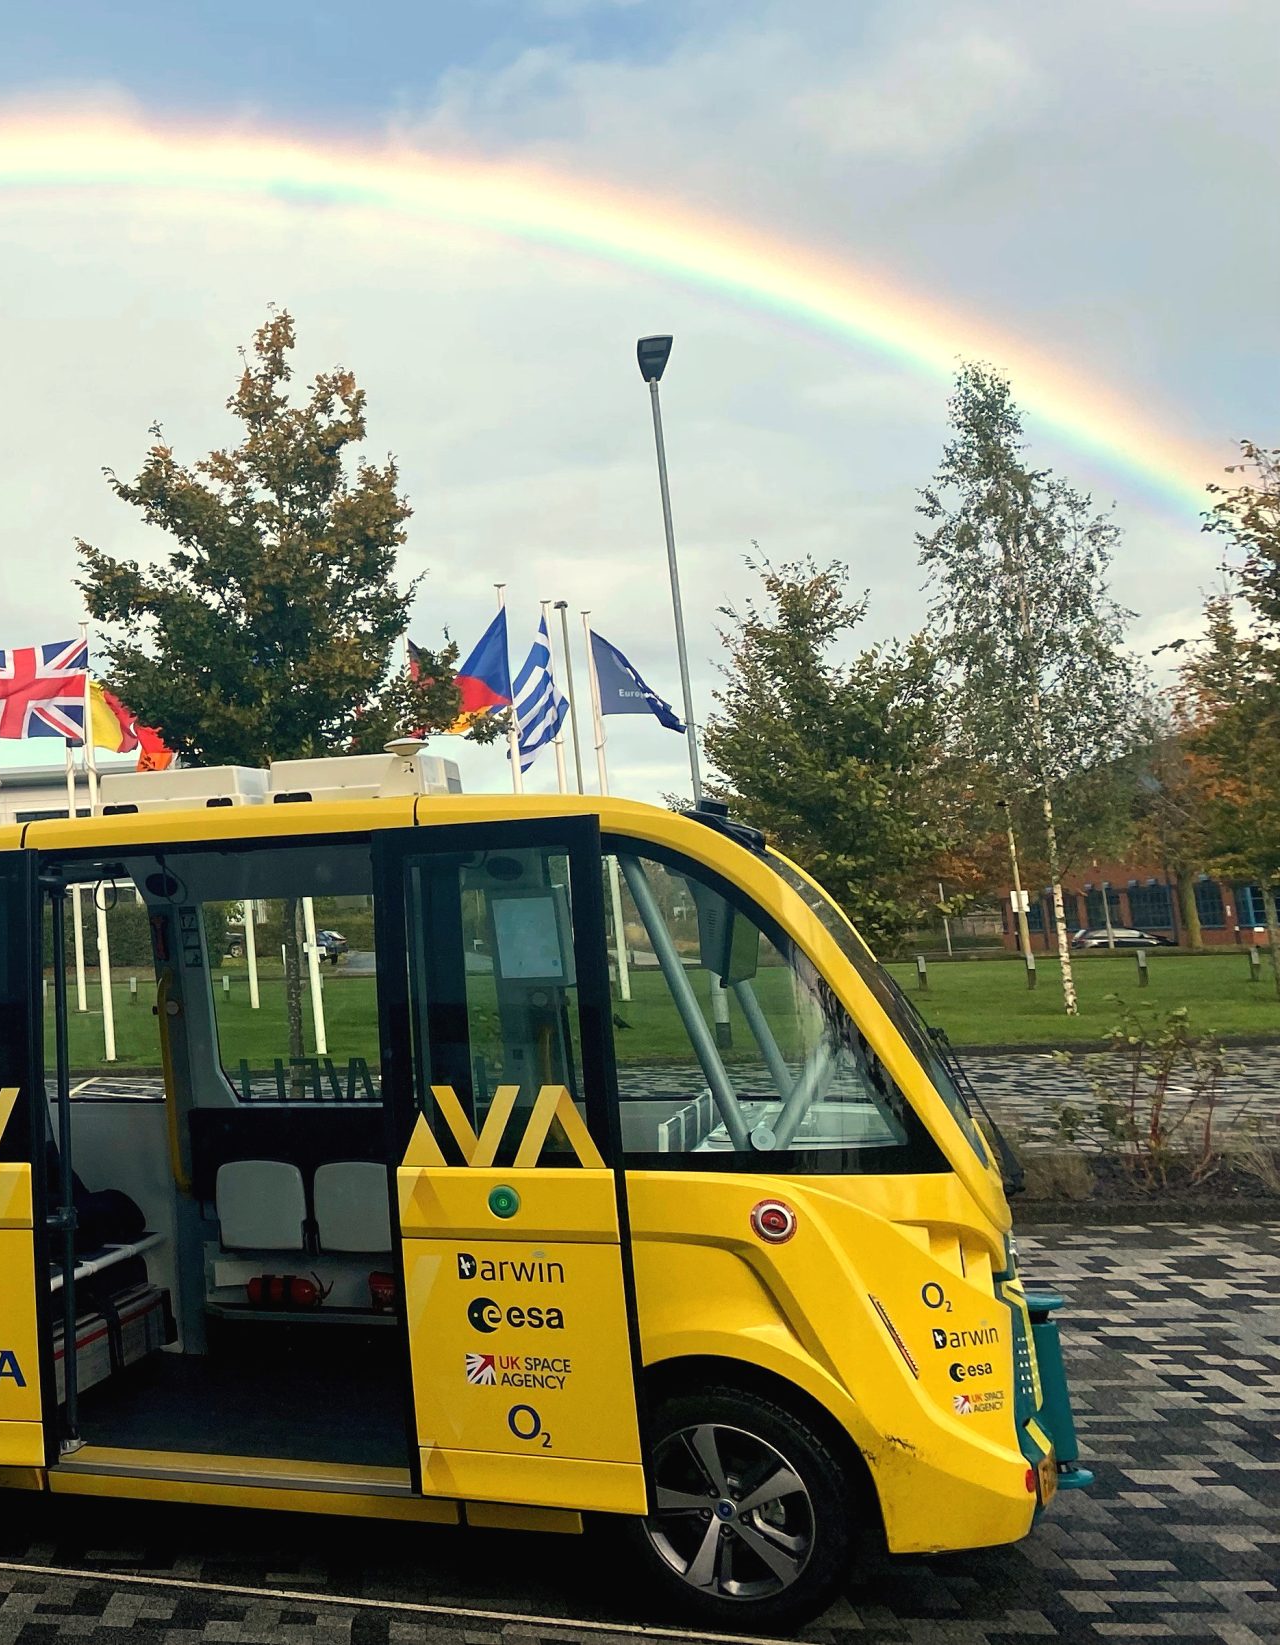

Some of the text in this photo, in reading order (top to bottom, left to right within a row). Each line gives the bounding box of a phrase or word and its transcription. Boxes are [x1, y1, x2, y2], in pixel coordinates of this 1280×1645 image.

[457, 1253, 565, 1283] Darwin
[932, 1326, 1000, 1350] Darwin
[499, 1356, 572, 1373] UK SPACE
[500, 1373, 566, 1390] AGENCY
[971, 1391, 1004, 1403] UK SPACE
[973, 1402, 1004, 1413] AGENCY
